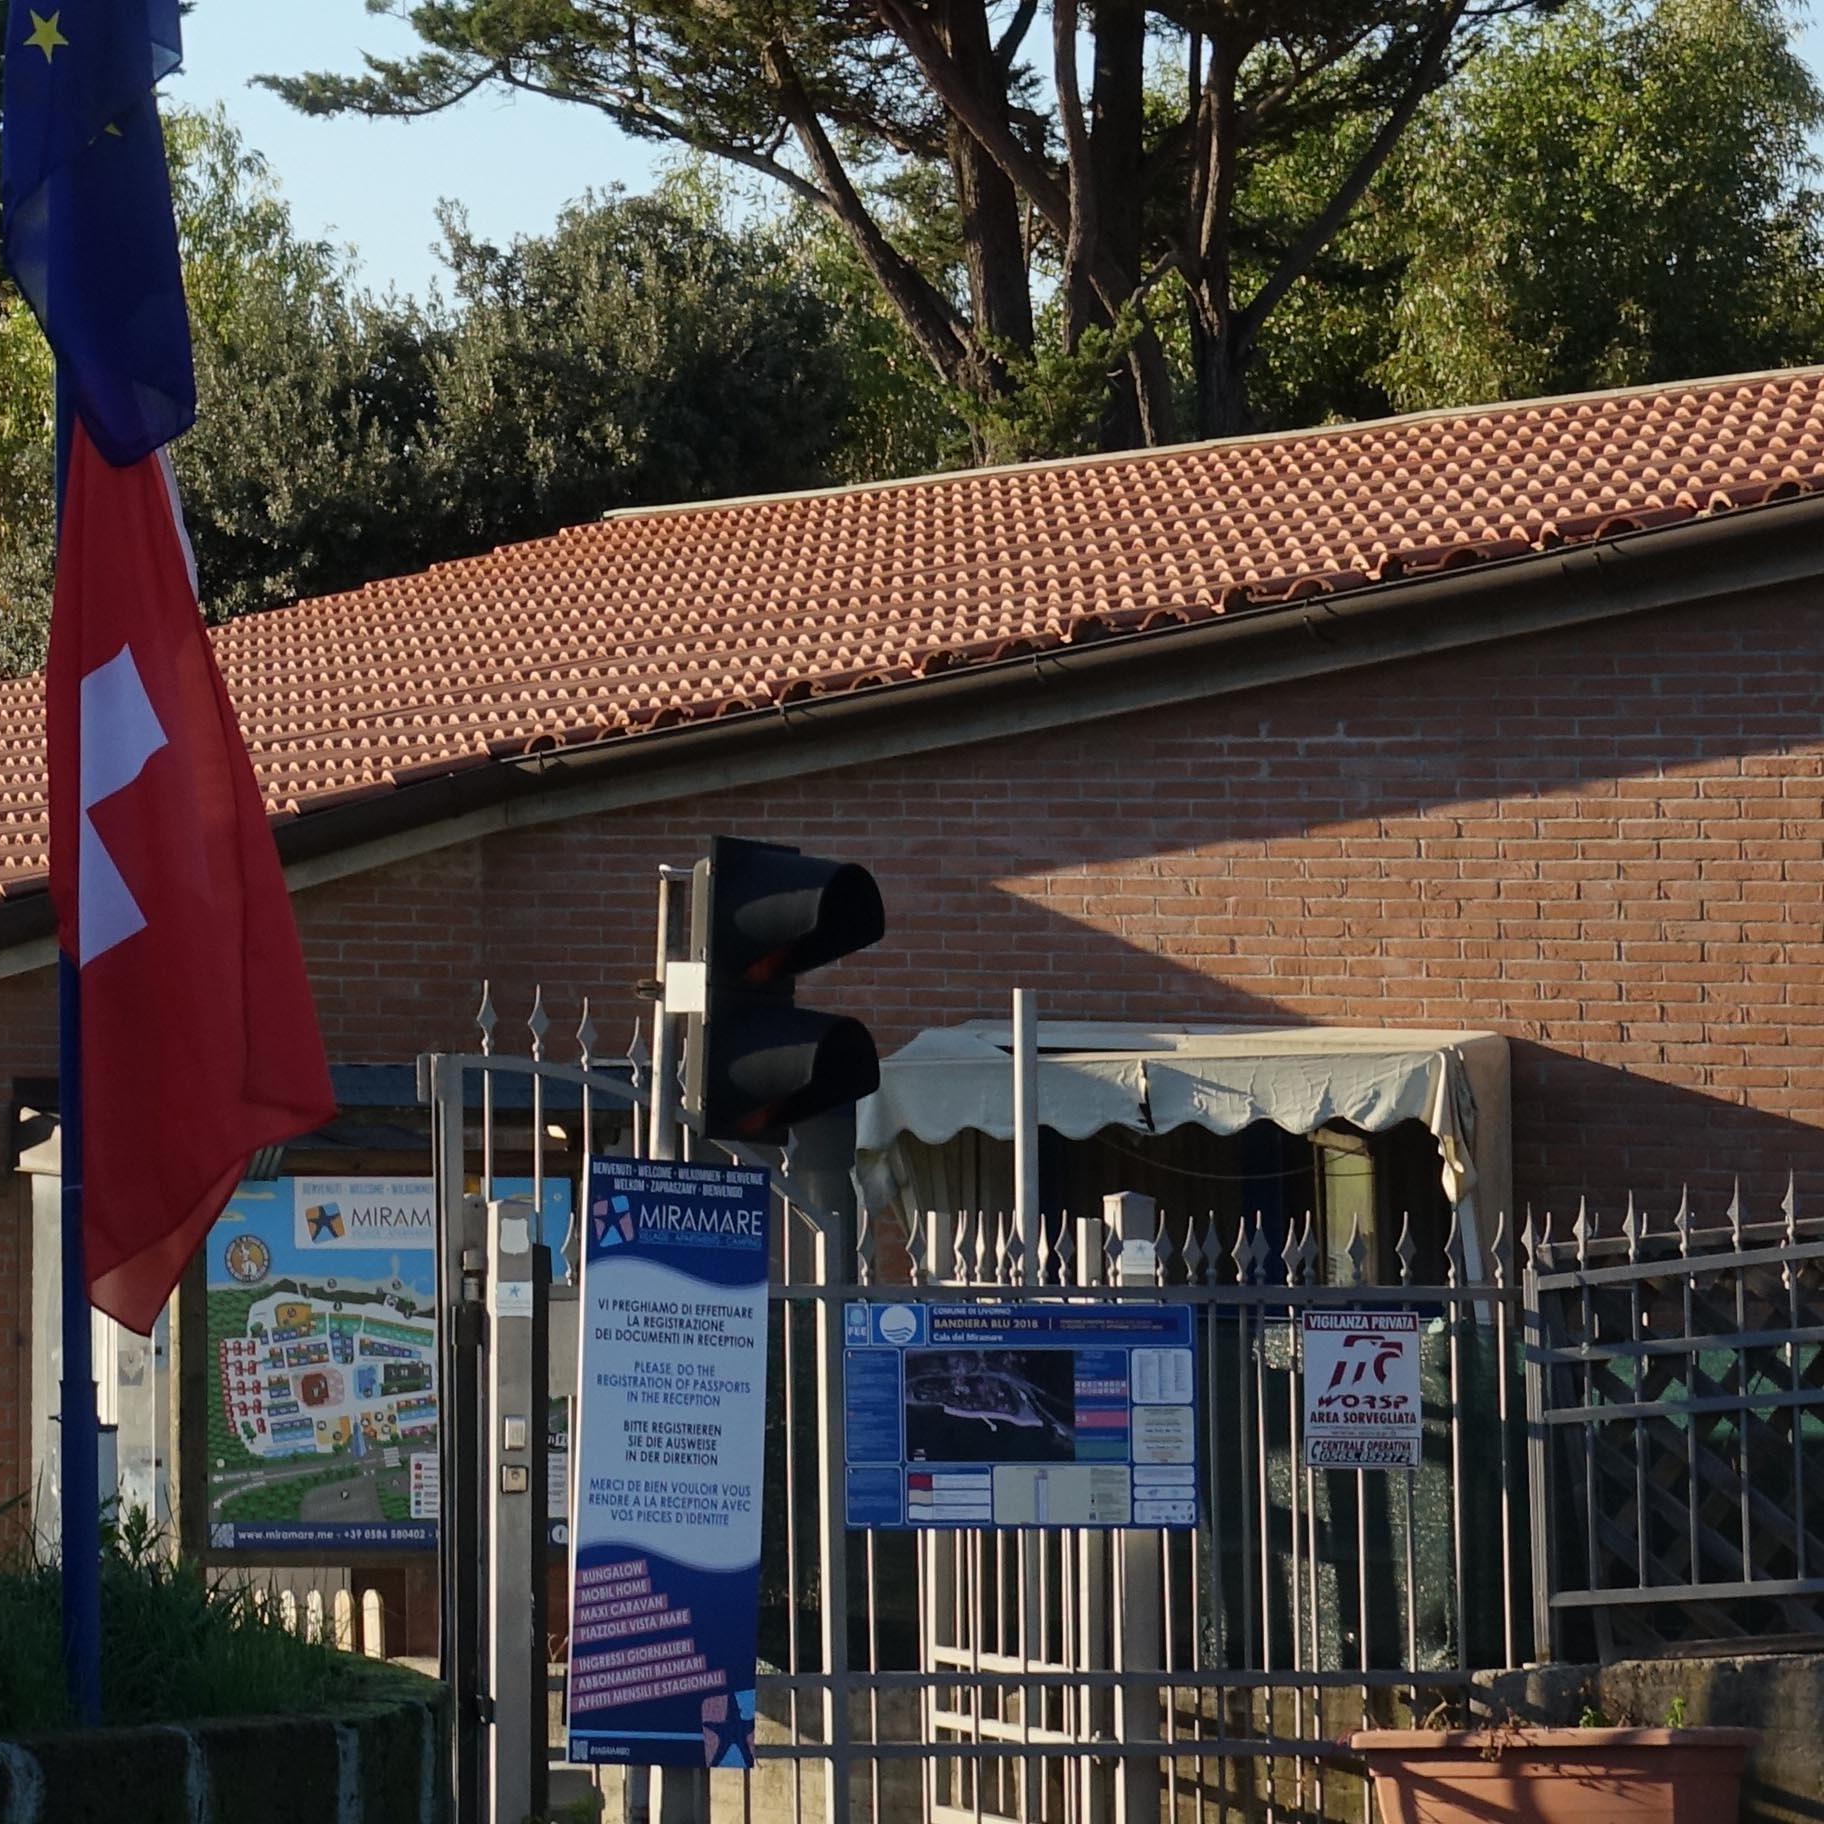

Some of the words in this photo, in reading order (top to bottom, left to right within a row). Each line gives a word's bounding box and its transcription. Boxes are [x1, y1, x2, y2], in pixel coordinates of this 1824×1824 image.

[638, 1165, 672, 1179] WELCOME
[614, 1178, 645, 1192] WELKOM
[351, 1207, 432, 1227] MIRAM
[639, 1204, 764, 1236] MIRAMARE
[598, 1298, 609, 1311] VI
[612, 1299, 678, 1315] PREGHIAMO
[682, 1303, 692, 1315] DI
[695, 1305, 753, 1319] EFFETTUARE
[933, 1307, 966, 1316] COMUNE
[968, 1307, 977, 1315] DI
[978, 1307, 1012, 1316] LIVORNO
[627, 1315, 640, 1327] LA
[643, 1316, 725, 1332] REGISTRAZIONE
[934, 1319, 988, 1329] BANDIERA
[991, 1319, 1011, 1329] BLU
[1013, 1319, 1039, 1329] 2018
[1310, 1315, 1368, 1330] VIGILANZA
[1372, 1316, 1414, 1330] PRIVATA
[595, 1328, 611, 1341] DEI
[615, 1329, 680, 1344] DOCUMENTI
[683, 1333, 694, 1345] IN
[697, 1335, 754, 1349] RECEPTION
[847, 1326, 867, 1337] FEE
[933, 1333, 951, 1342] Cala
[966, 1333, 1004, 1342] Miramare
[634, 1361, 671, 1374] PLEASE
[677, 1364, 694, 1376] DO
[697, 1365, 715, 1377] THE
[597, 1374, 671, 1390] REGISTRATION
[676, 1378, 690, 1391] OF
[693, 1380, 751, 1394] PASSPORTS
[627, 1391, 638, 1403] IN
[641, 1392, 660, 1404] THE
[663, 1393, 721, 1407] RECEPTION
[1318, 1394, 1409, 1409] WORSP
[1310, 1411, 1340, 1424] AREA
[1343, 1412, 1417, 1424] SORVEGLIATA
[624, 1420, 648, 1433] BITTE
[652, 1422, 722, 1436] REGISTRIEREN
[628, 1435, 642, 1448] SIE
[646, 1436, 663, 1449] DIE
[665, 1437, 717, 1451] AUSWEISE
[1321, 1440, 1364, 1452] CENTRALE
[1367, 1440, 1411, 1452] OPERATIVA
[625, 1450, 636, 1462] IN
[640, 1451, 660, 1463] DER
[663, 1452, 718, 1466] DIREKTION
[590, 1478, 624, 1491] MERCI
[628, 1480, 640, 1492] DE
[644, 1481, 667, 1493] BIEN
[671, 1482, 718, 1495] VOULOIR
[721, 1484, 751, 1497] VOUS
[589, 1493, 630, 1506] RENDRE
[644, 1496, 657, 1508] LA
[661, 1497, 718, 1511] RECEPTION
[721, 1499, 751, 1512] AVEC
[611, 1509, 633, 1522] VOS
[238, 1531, 333, 1541] www.miramare.me
[582, 1561, 643, 1584] BUNGALOW
[581, 1585, 614, 1603] MOBIL
[616, 1581, 647, 1596] HOME
[580, 1605, 608, 1621] MAXI
[611, 1596, 663, 1616] CARAVAN
[580, 1622, 628, 1641] PIAZZOLE
[630, 1617, 657, 1632] VISTA
[659, 1609, 689, 1626] MARE
[579, 1653, 625, 1672] INGRESSI
[627, 1642, 691, 1663] GIORNALIERI
[578, 1666, 652, 1691] ABBONAMENTI
[655, 1656, 703, 1676] BALNEARI
[577, 1692, 611, 1710] AFFITTI
[613, 1685, 652, 1703] MENSILI
[654, 1684, 660, 1696] E
[661, 1672, 723, 1695] STAGIONALI
